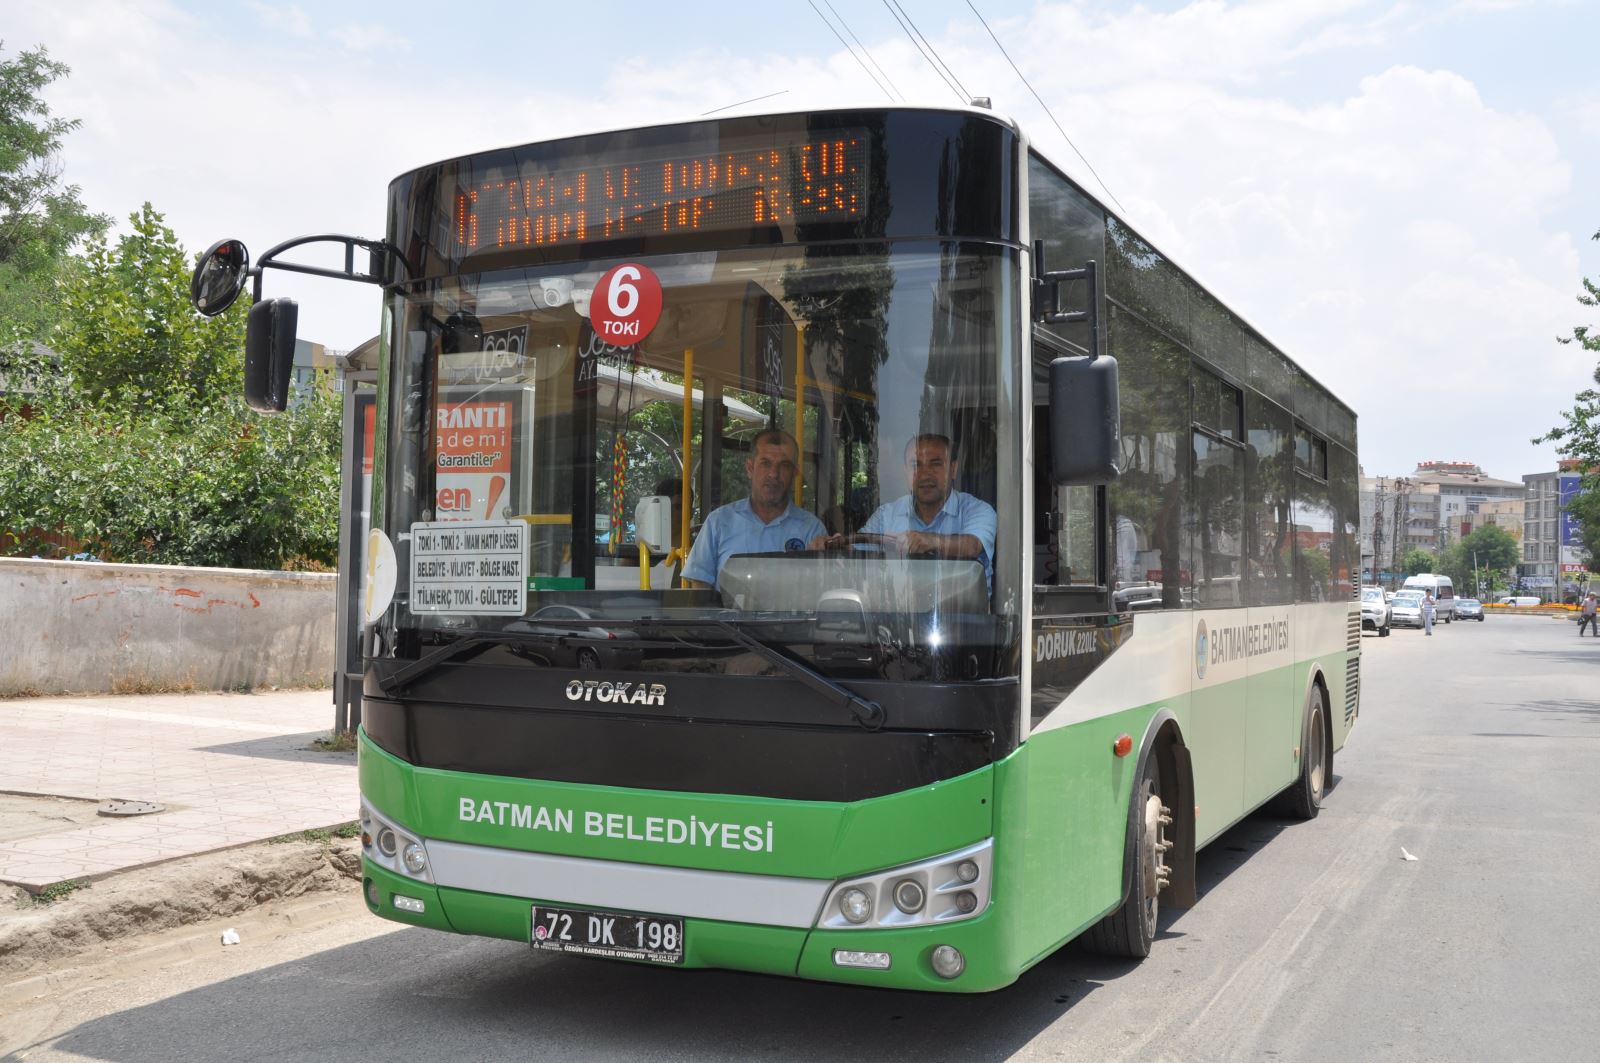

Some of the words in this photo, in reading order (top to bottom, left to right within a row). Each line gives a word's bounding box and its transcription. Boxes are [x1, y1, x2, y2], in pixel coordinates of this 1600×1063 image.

[608, 266, 641, 317] 6
[603, 320, 640, 336] TOKİ
[418, 533, 432, 551] TOKİ
[441, 531, 455, 550] TOKİ
[456, 535, 460, 550] 2
[464, 531, 480, 550] İMAM
[481, 530, 499, 550] HATİP
[500, 530, 519, 549] LİSESİ
[417, 559, 446, 577] BELEDİYE
[450, 558, 476, 576] VİLAYET
[480, 558, 501, 577] BÖLGE
[502, 561, 520, 576] HAST.
[417, 586, 452, 609] TİLMERÇ
[454, 586, 473, 605] TOKİ
[480, 586, 518, 605] GÜLTEPE
[1037, 630, 1077, 662] DORUK
[566, 680, 667, 706] OTOKAR
[459, 797, 573, 834] BATMAN
[584, 811, 774, 853] BELEDİYESİ
[546, 912, 572, 940] 72
[588, 916, 615, 945] DK
[635, 920, 677, 950] 198
